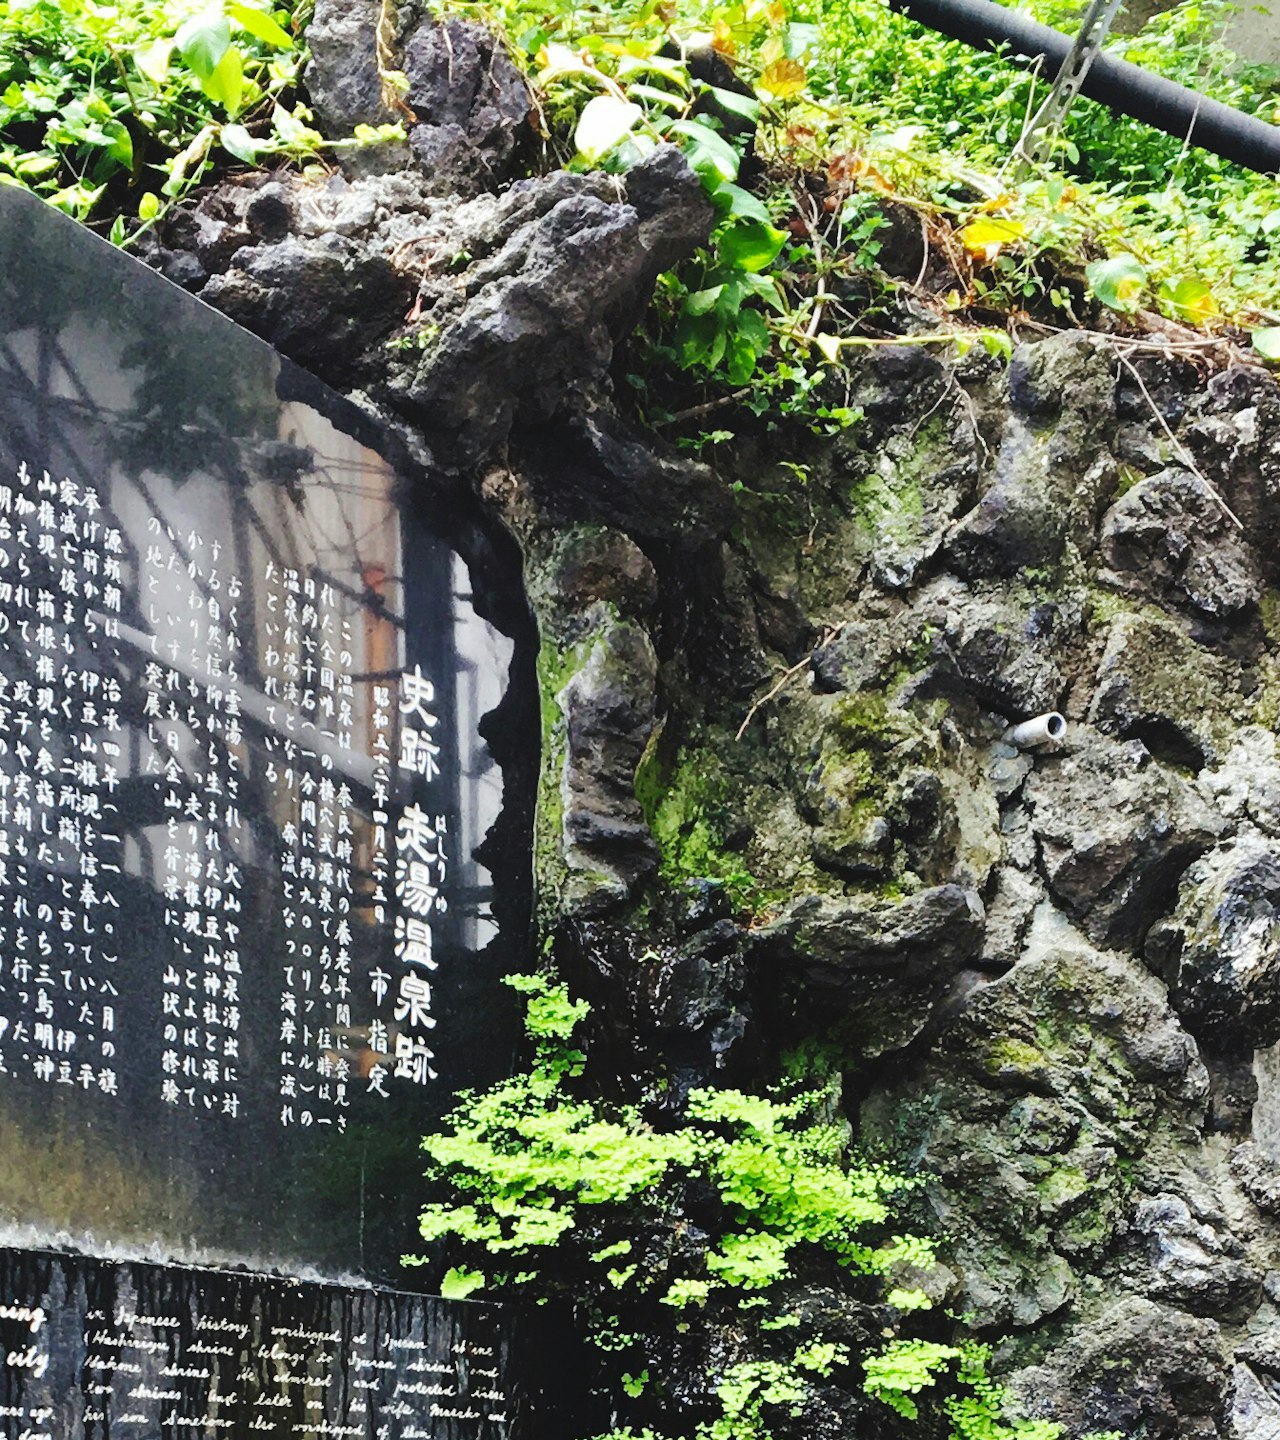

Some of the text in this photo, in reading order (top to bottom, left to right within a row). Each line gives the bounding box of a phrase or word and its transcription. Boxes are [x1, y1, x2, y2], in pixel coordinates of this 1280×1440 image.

[366, 686, 392, 1098] 昭和五十二年四月二十五日 市指定
[186, 1341, 235, 1356] shrine
[316, 1352, 333, 1363] to
[352, 1334, 367, 1345] at
[7, 1344, 49, 1378] city
[353, 1378, 380, 1391] and
[253, 1392, 293, 1407] later
[349, 1398, 366, 1413] his
[488, 1411, 507, 1422] and
[117, 1413, 149, 1424] son
[376, 1424, 389, 1440] of
